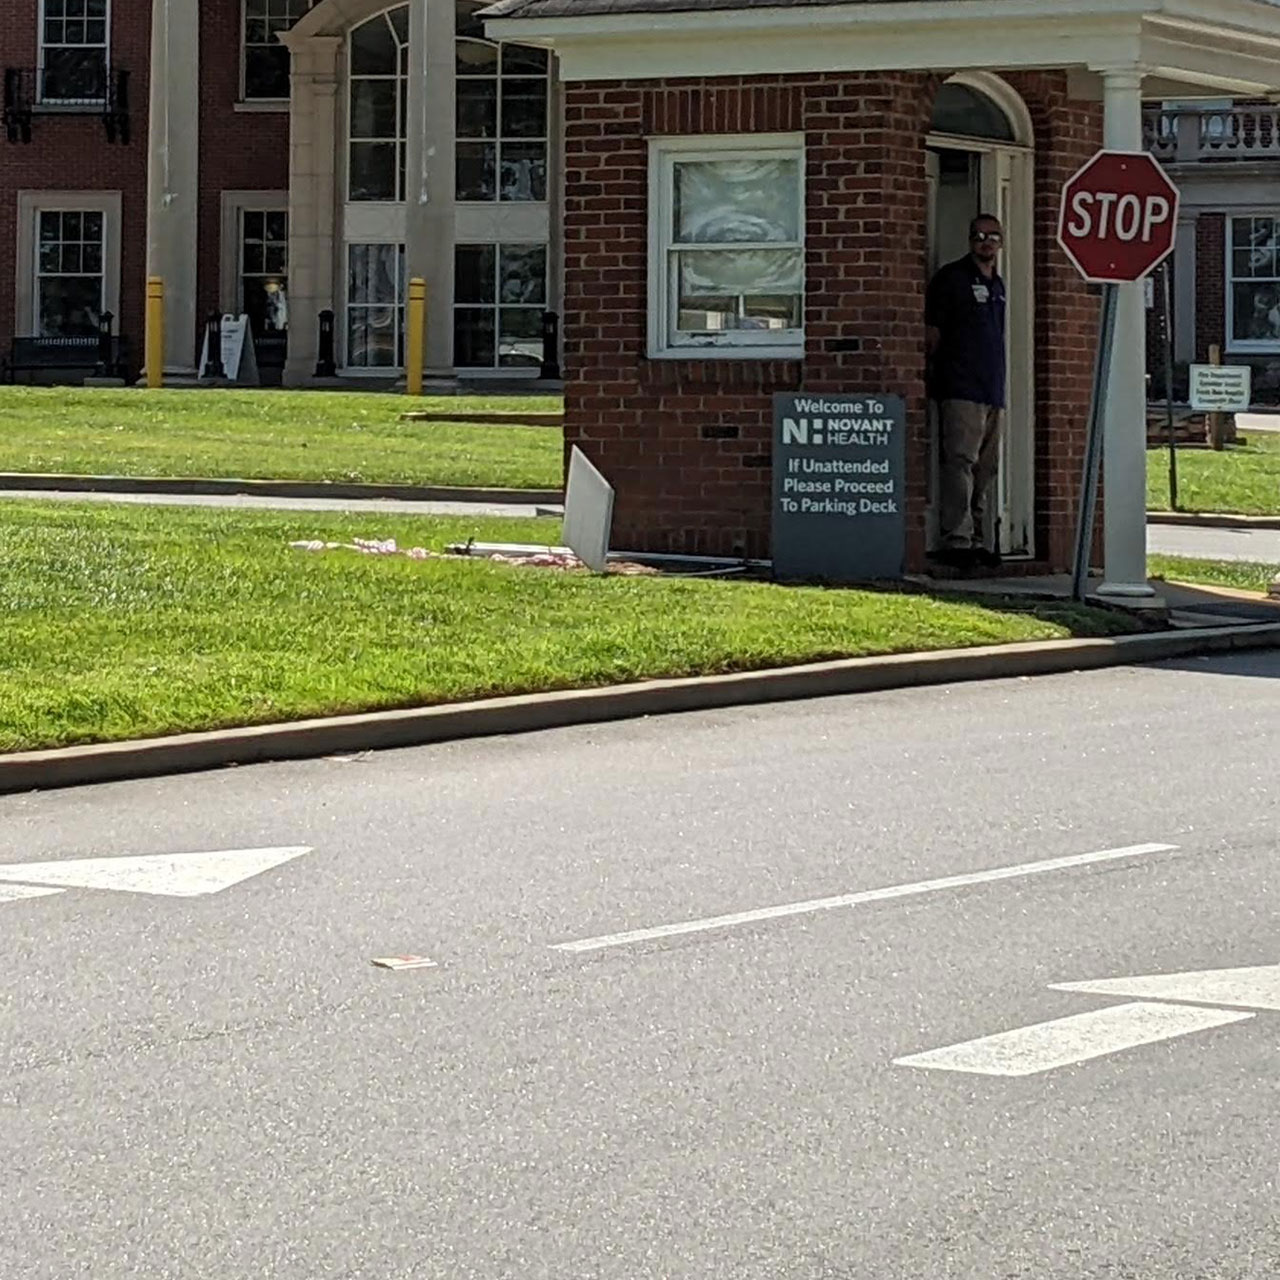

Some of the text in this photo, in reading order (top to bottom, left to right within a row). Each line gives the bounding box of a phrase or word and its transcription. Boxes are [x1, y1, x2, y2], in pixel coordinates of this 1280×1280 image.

[1068, 191, 1170, 242] STOP
[794, 398, 884, 414] Welcome To
[827, 418, 895, 432] NOVANT
[827, 432, 889, 446] HEALTH
[788, 458, 890, 474] If Unattended
[784, 478, 895, 494] Please Proceed
[780, 497, 898, 516] To Parking Deck
